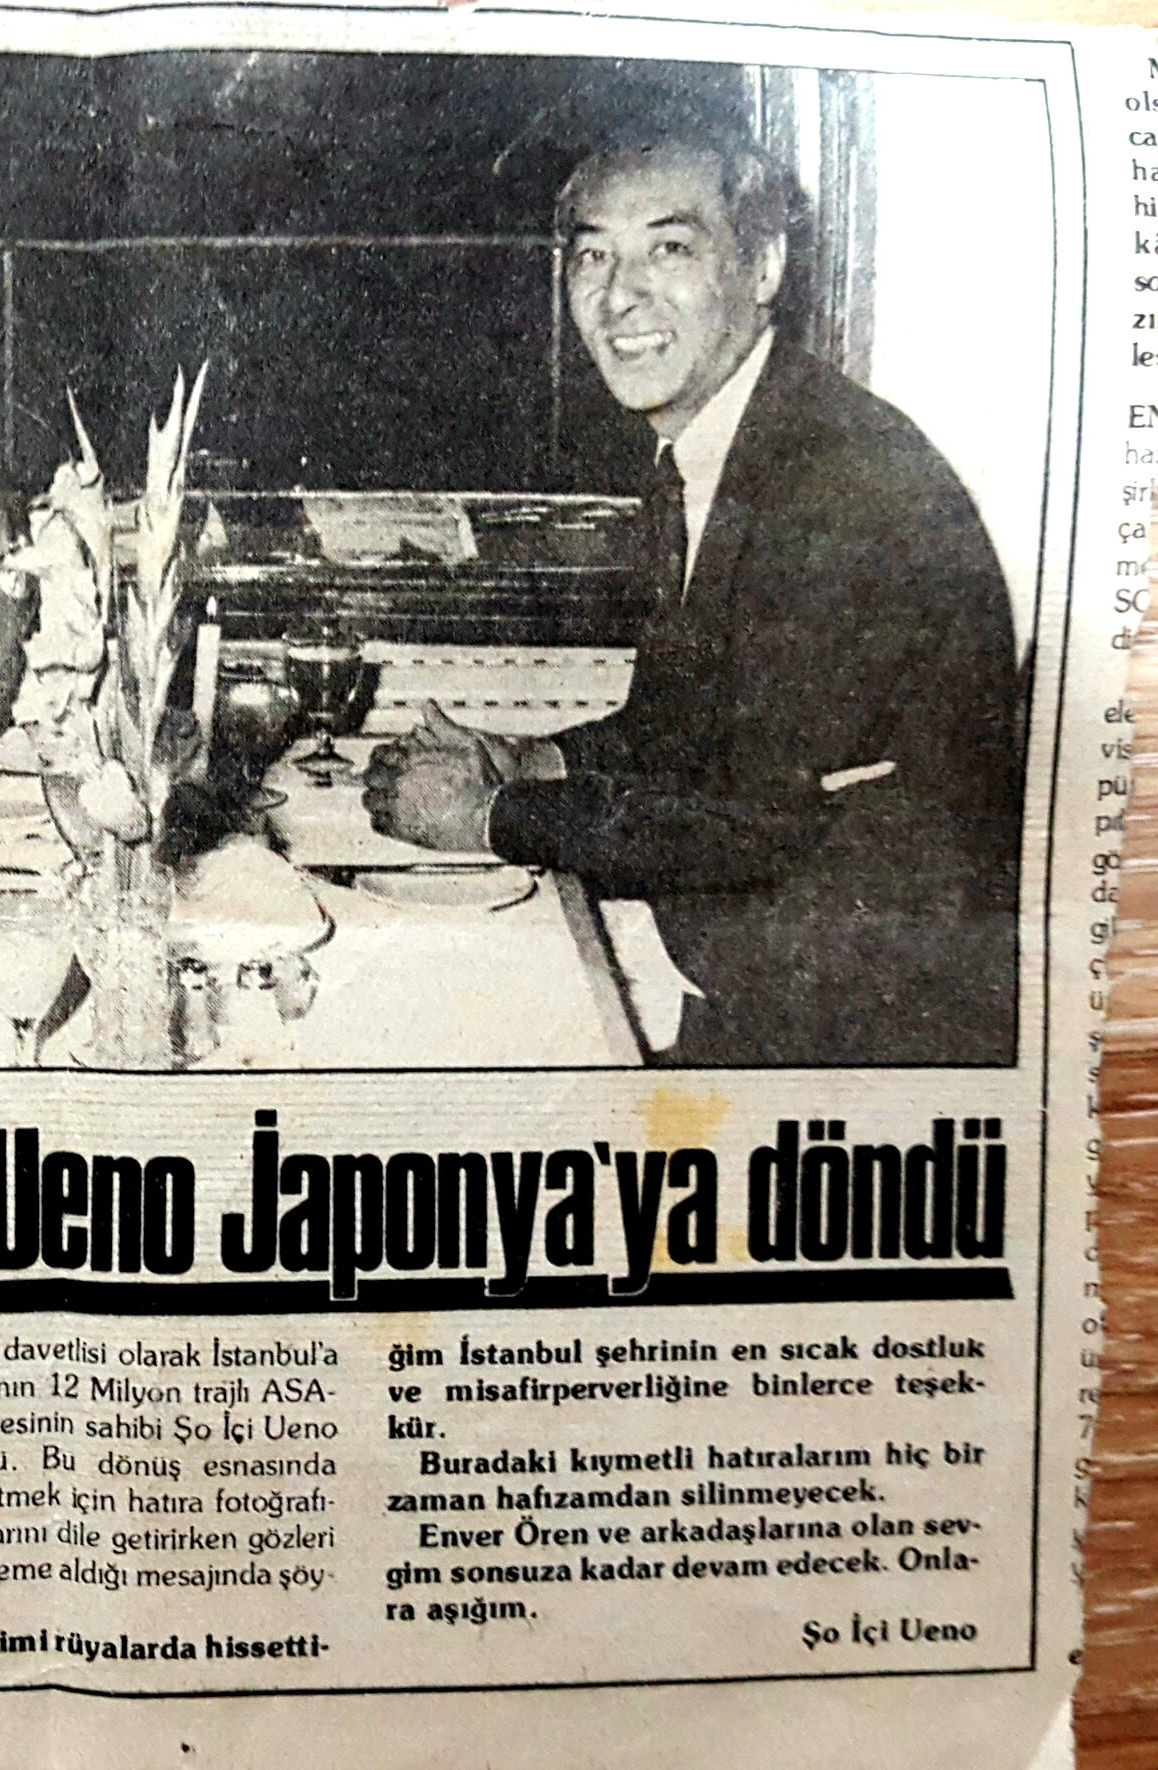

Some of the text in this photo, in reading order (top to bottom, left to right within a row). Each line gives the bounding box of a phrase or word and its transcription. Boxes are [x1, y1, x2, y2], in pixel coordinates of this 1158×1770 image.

[749, 1119, 1004, 1262] döndü
[4, 1336, 106, 1364] davetlisi
[119, 1341, 201, 1368] olarak
[213, 1337, 338, 1367] İstanbul'a
[388, 1334, 985, 1372] ğim İstanbul şehrinin en sıcak dostluk
[51, 1372, 79, 1399] 12
[90, 1376, 181, 1409] Milyon
[194, 1378, 249, 1408] trajlı
[262, 1378, 335, 1403] ASA-
[388, 1368, 986, 1407] ve misafirperverliğine binlerce teşek-
[86, 1413, 162, 1440] sahibi
[173, 1415, 212, 1446] Şo
[224, 1410, 253, 1445] İçi
[265, 1415, 338, 1441] Ueno
[388, 1414, 445, 1440] kür.
[43, 1445, 75, 1471] Bu
[98, 1451, 181, 1482] dönüş
[203, 1452, 337, 1477] esnasında
[420, 1441, 986, 1477] Buradaki kıymetli hatıralarım hiç bir
[72, 1487, 115, 1515] için
[129, 1487, 203, 1514] hatıra
[216, 1487, 334, 1519] fotoğrafı-
[386, 1477, 885, 1513] zaman hafızamdan silinmeyecek.
[57, 1520, 101, 1547] dile
[112, 1526, 237, 1555] getirirken
[248, 1524, 334, 1555] gözleri
[419, 1512, 982, 1549] Enver Ören ve arkadaşlarına olan sev-
[59, 1557, 127, 1591] aldığı
[137, 1561, 272, 1592] mesajında
[279, 1565, 334, 1592] şöy-
[386, 1545, 980, 1591] gim sonsuza kadar devam edecek. Onla-
[386, 1597, 537, 1626] ra aşığım.
[55, 1632, 197, 1663] rüyalarda
[205, 1633, 329, 1660] hissetti-
[802, 1612, 978, 1651] Şo İçi Ueno
